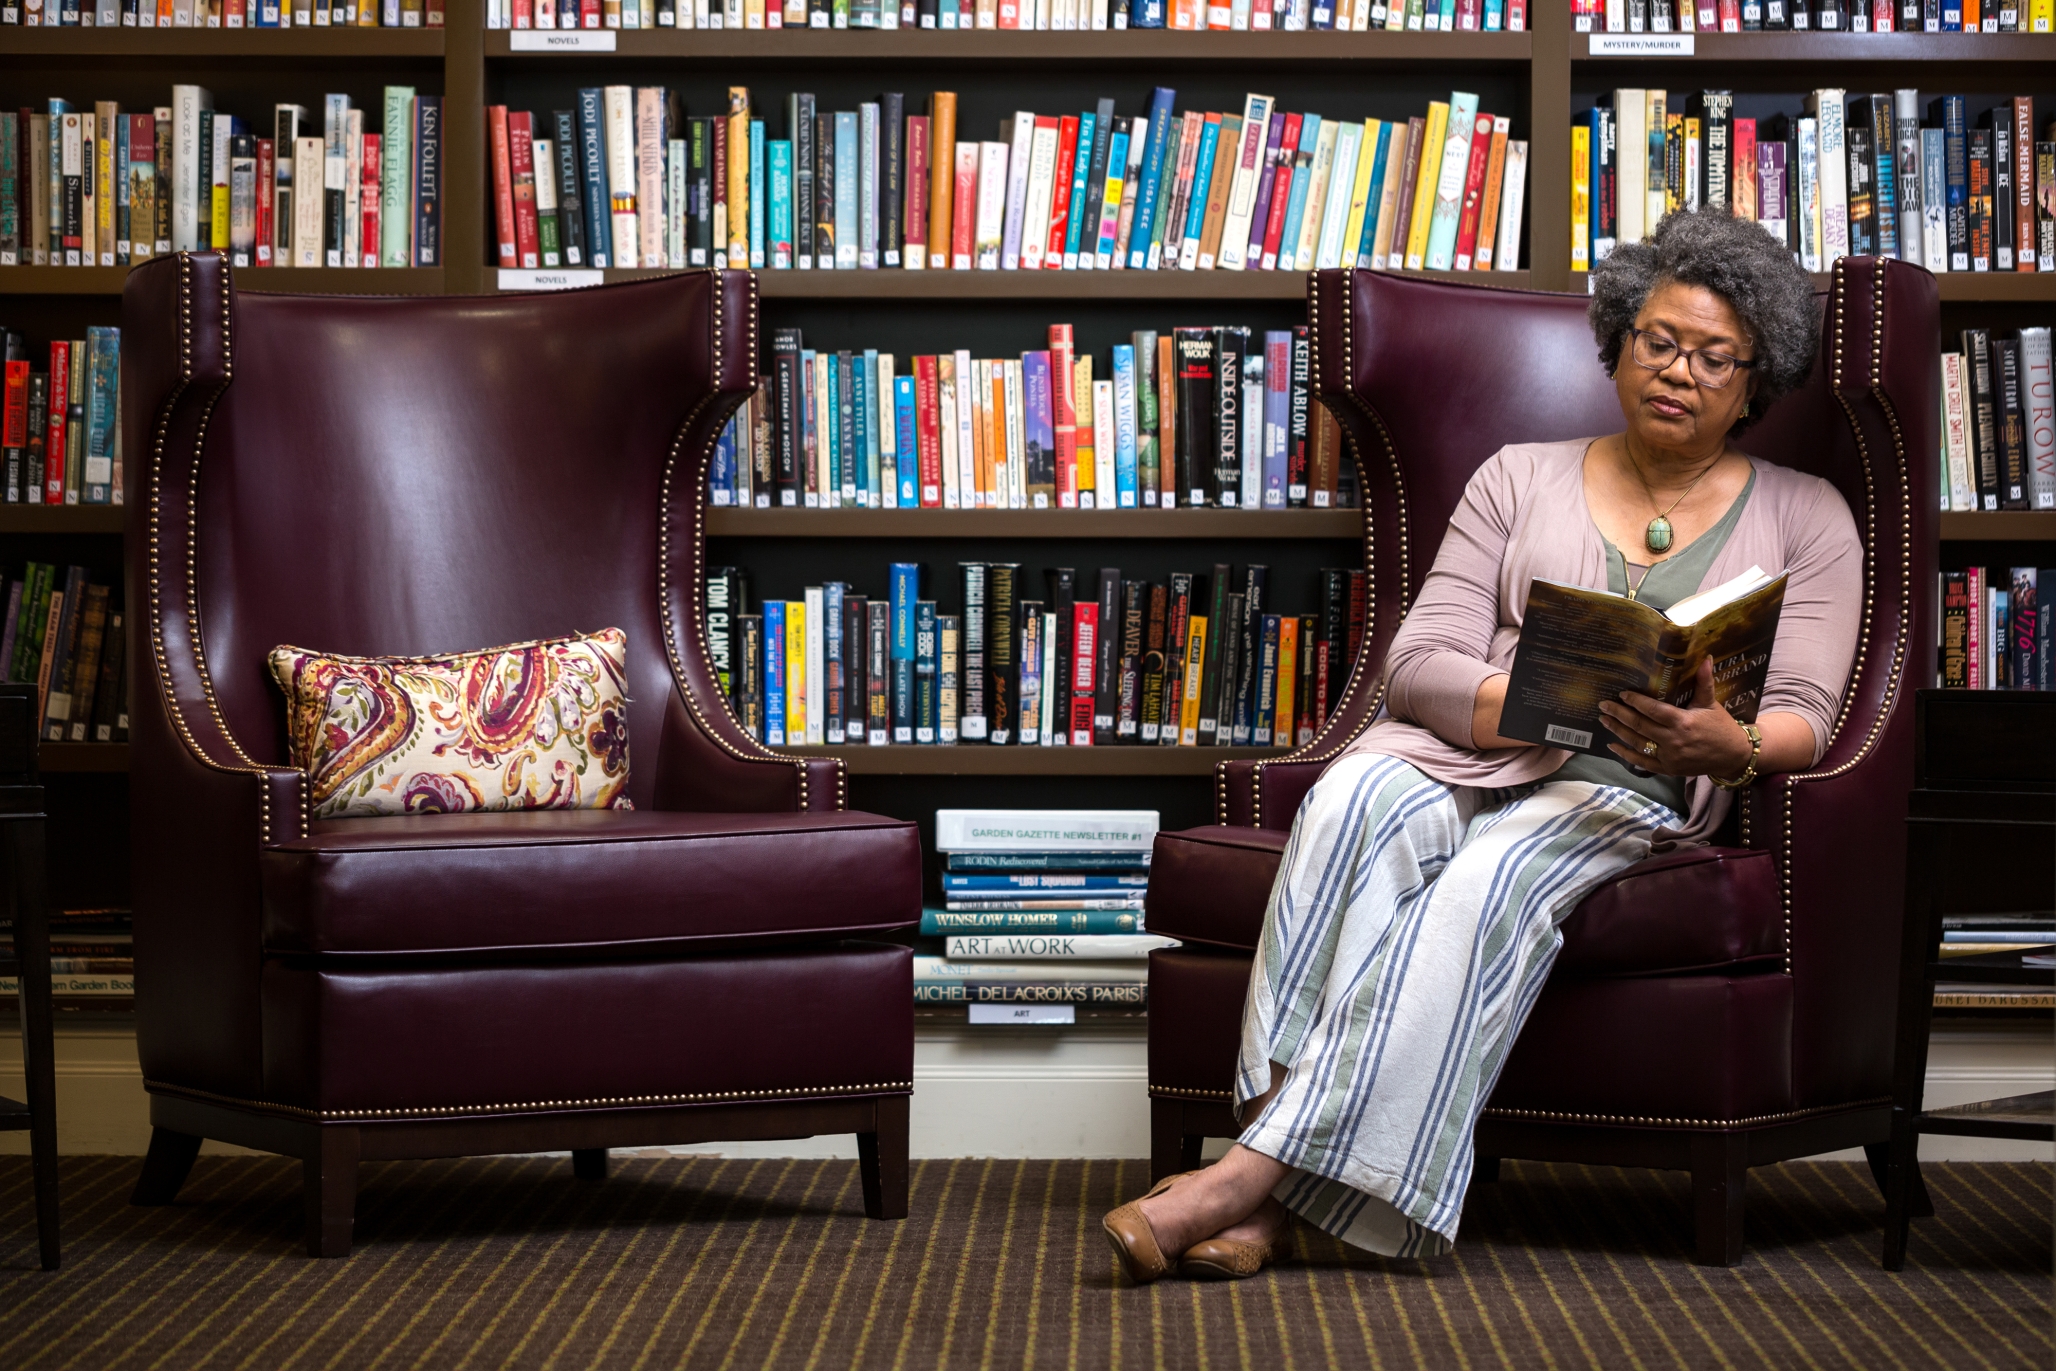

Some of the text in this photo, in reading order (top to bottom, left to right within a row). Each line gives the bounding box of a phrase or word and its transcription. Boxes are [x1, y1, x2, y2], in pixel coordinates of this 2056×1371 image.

[547, 36, 580, 46] NOVELS
[1603, 40, 1681, 50] MYSTERY/MURDER
[1703, 95, 1733, 108] STEPHEN
[1709, 107, 1727, 120] KING
[1599, 111, 1610, 166] kemelman
[1709, 125, 1727, 147] THE
[1822, 101, 1834, 153] LEONARD
[1832, 104, 1844, 149] ELMORE
[1883, 103, 1892, 151] ELIZABETH
[1896, 118, 1920, 129] CHUCK
[1896, 129, 1919, 140] LOGAN
[180, 97, 193, 227] Look at Me Jennifer Egan
[202, 113, 211, 206] THE GREEN ROAD
[387, 96, 399, 207] FANNIE FLAGG
[422, 105, 438, 200] KEN FOLLETT
[512, 128, 521, 168] TRUTH
[522, 130, 530, 164] PLAIN
[557, 114, 576, 195] JODI PICOULT
[1446, 151, 1465, 159] NEST
[800, 107, 812, 245] CLOUD NINE LUANNE RICE
[1141, 108, 1167, 230] DREAMS JOY LISA SEE
[1900, 177, 1921, 189] THE
[1971, 159, 1982, 195] MARTINI
[1899, 189, 1920, 200] BIG
[1899, 200, 1920, 212] LAW
[1824, 208, 1837, 245] DEAKY
[1836, 205, 1848, 249] FREAKY
[1948, 206, 1958, 248] MURDER
[1957, 206, 1966, 245] CAPITOL
[535, 275, 567, 285] NOVELS
[1179, 341, 1214, 350] HERMAN
[1184, 350, 1211, 358] WOUK
[1294, 340, 1309, 382] KEITH
[782, 371, 791, 419] GENTLEMAN
[928, 362, 938, 427] CUTTING FOR
[1029, 375, 1039, 407] PONIES
[1036, 365, 1048, 418] BLIND YOUR
[1143, 337, 1153, 423] BEATRIZ WILLIAMS
[1945, 355, 1963, 445] MARTIN CRUZ SMITH
[856, 376, 864, 437] ANNE TYLER
[1118, 358, 1133, 451] SUSAN WIGGS
[1292, 384, 1308, 437] ABLOW
[2004, 350, 2020, 484] SCOTT TUROW ERRORS
[2029, 358, 2056, 478] TUROW
[783, 422, 791, 431] IN
[1098, 400, 1108, 460] SUSAN WIGGS
[783, 434, 792, 472] MOSCOW
[991, 569, 1012, 667] PATRICIA CORNWELL
[1252, 586, 1261, 611] earl
[706, 575, 729, 670] TOM CLANCY
[1238, 569, 1256, 700] emerson the vanishing
[2013, 609, 2038, 655] 1776
[828, 594, 840, 715] THE GRAVING DOCK GABRIEL COHEN
[898, 574, 907, 718] MICHAEL CONNELLY THE LATE SHOW
[918, 632, 927, 657] COOK
[926, 632, 935, 658] ROBIN
[1077, 622, 1094, 688] JEFFERY DEAVER
[1121, 609, 1142, 707] DEAVER THE SLEEPING
[1261, 643, 1276, 711] Janet Evanovich
[1321, 645, 1330, 699] CODE TO
[972, 829, 1142, 841] GARDEN GAZETTE NEWSLETTER #1
[964, 855, 1049, 867] RODIN Rediscovered
[935, 913, 1058, 926] WINSLOW HOMER
[952, 938, 1075, 954] ART AT WORK
[70, 980, 108, 991] Garden
[930, 964, 973, 975] MONET
[914, 986, 1140, 1002] MICHEL DELACROIX'S PARIS
[1014, 1010, 1030, 1018] ART
